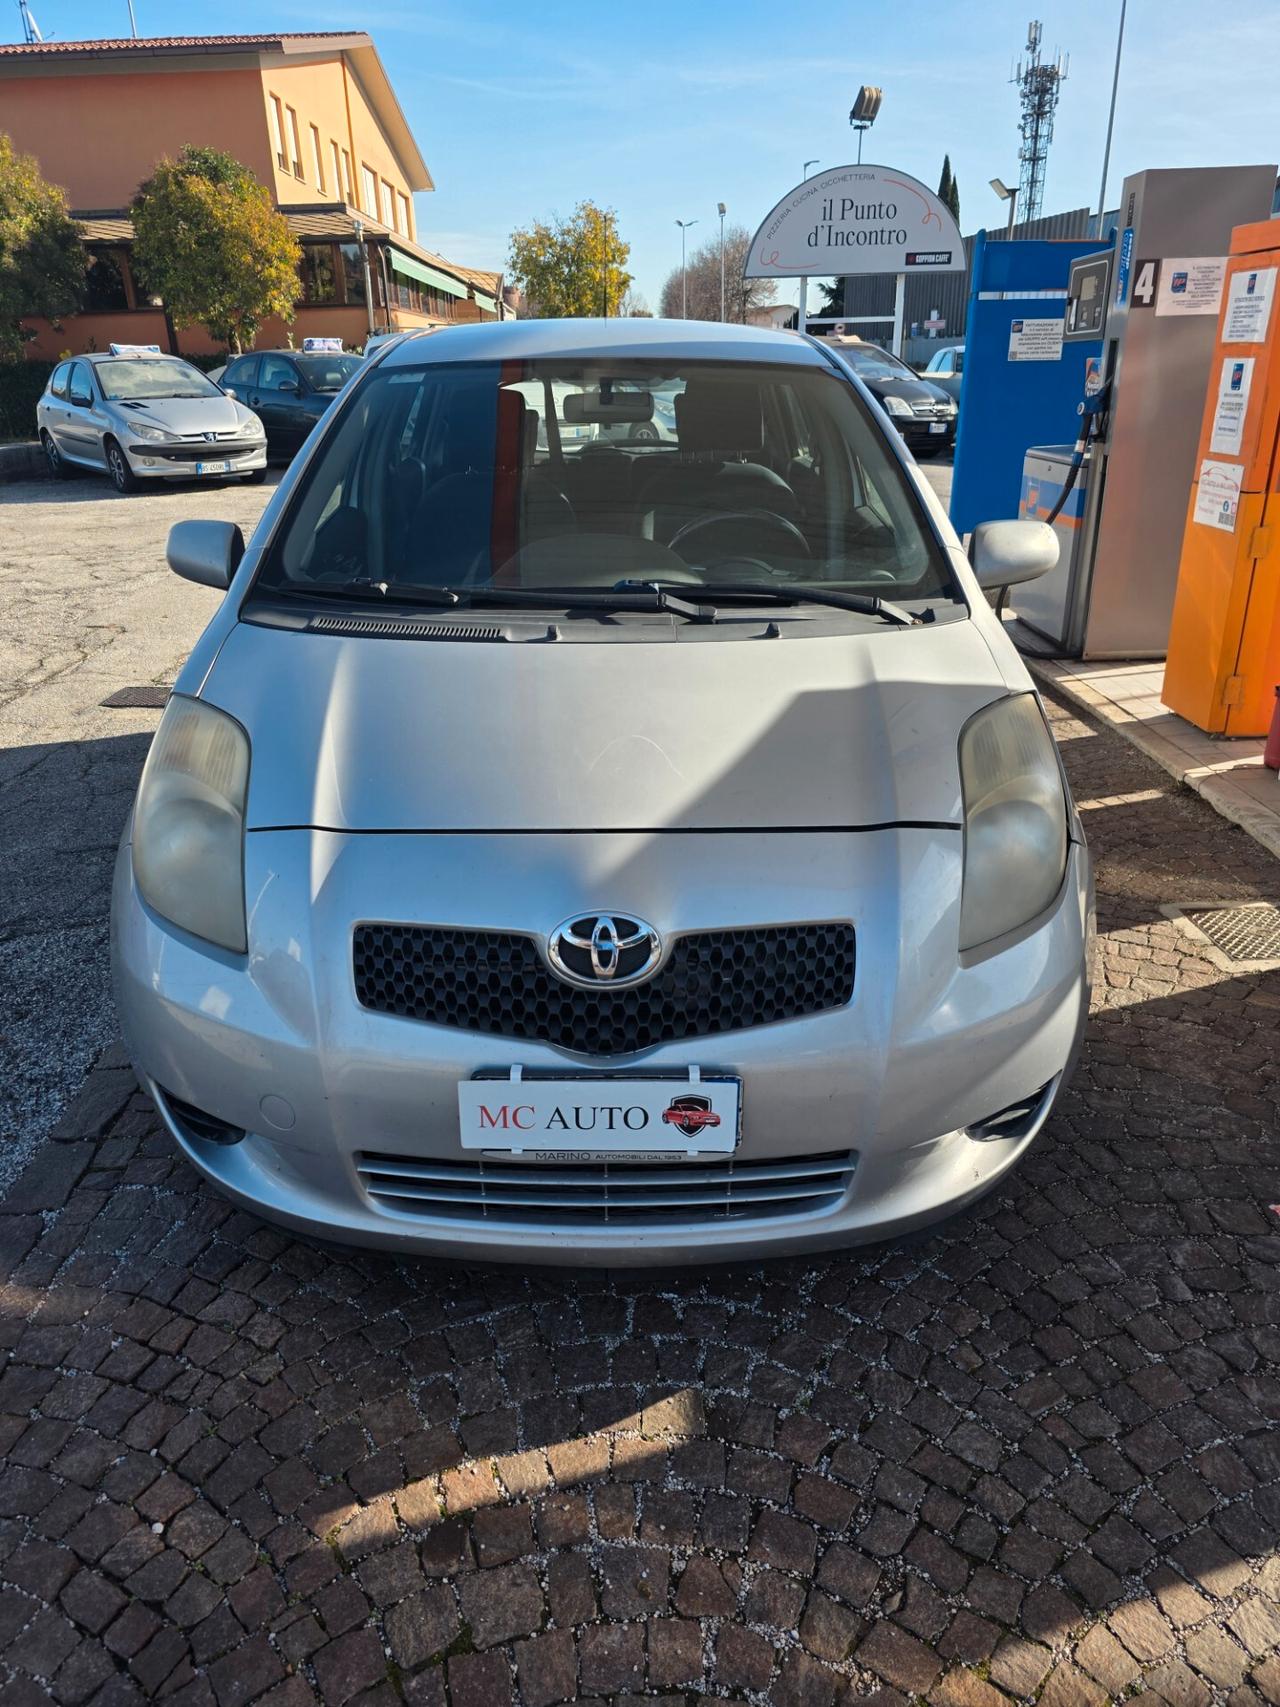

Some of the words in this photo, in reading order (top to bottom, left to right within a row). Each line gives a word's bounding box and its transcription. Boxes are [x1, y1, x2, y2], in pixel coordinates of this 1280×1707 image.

[766, 208, 792, 240] PIZZERIA
[792, 186, 819, 208] CUCINA
[820, 173, 876, 190] CICCHETTERIA
[821, 198, 834, 221] il
[840, 198, 898, 220] Punto
[806, 224, 908, 247] d'Incontro
[1134, 262, 1155, 304] 4
[477, 1105, 536, 1129] MC
[545, 1106, 650, 1130] AUTO
[535, 1152, 591, 1161] MARINO
